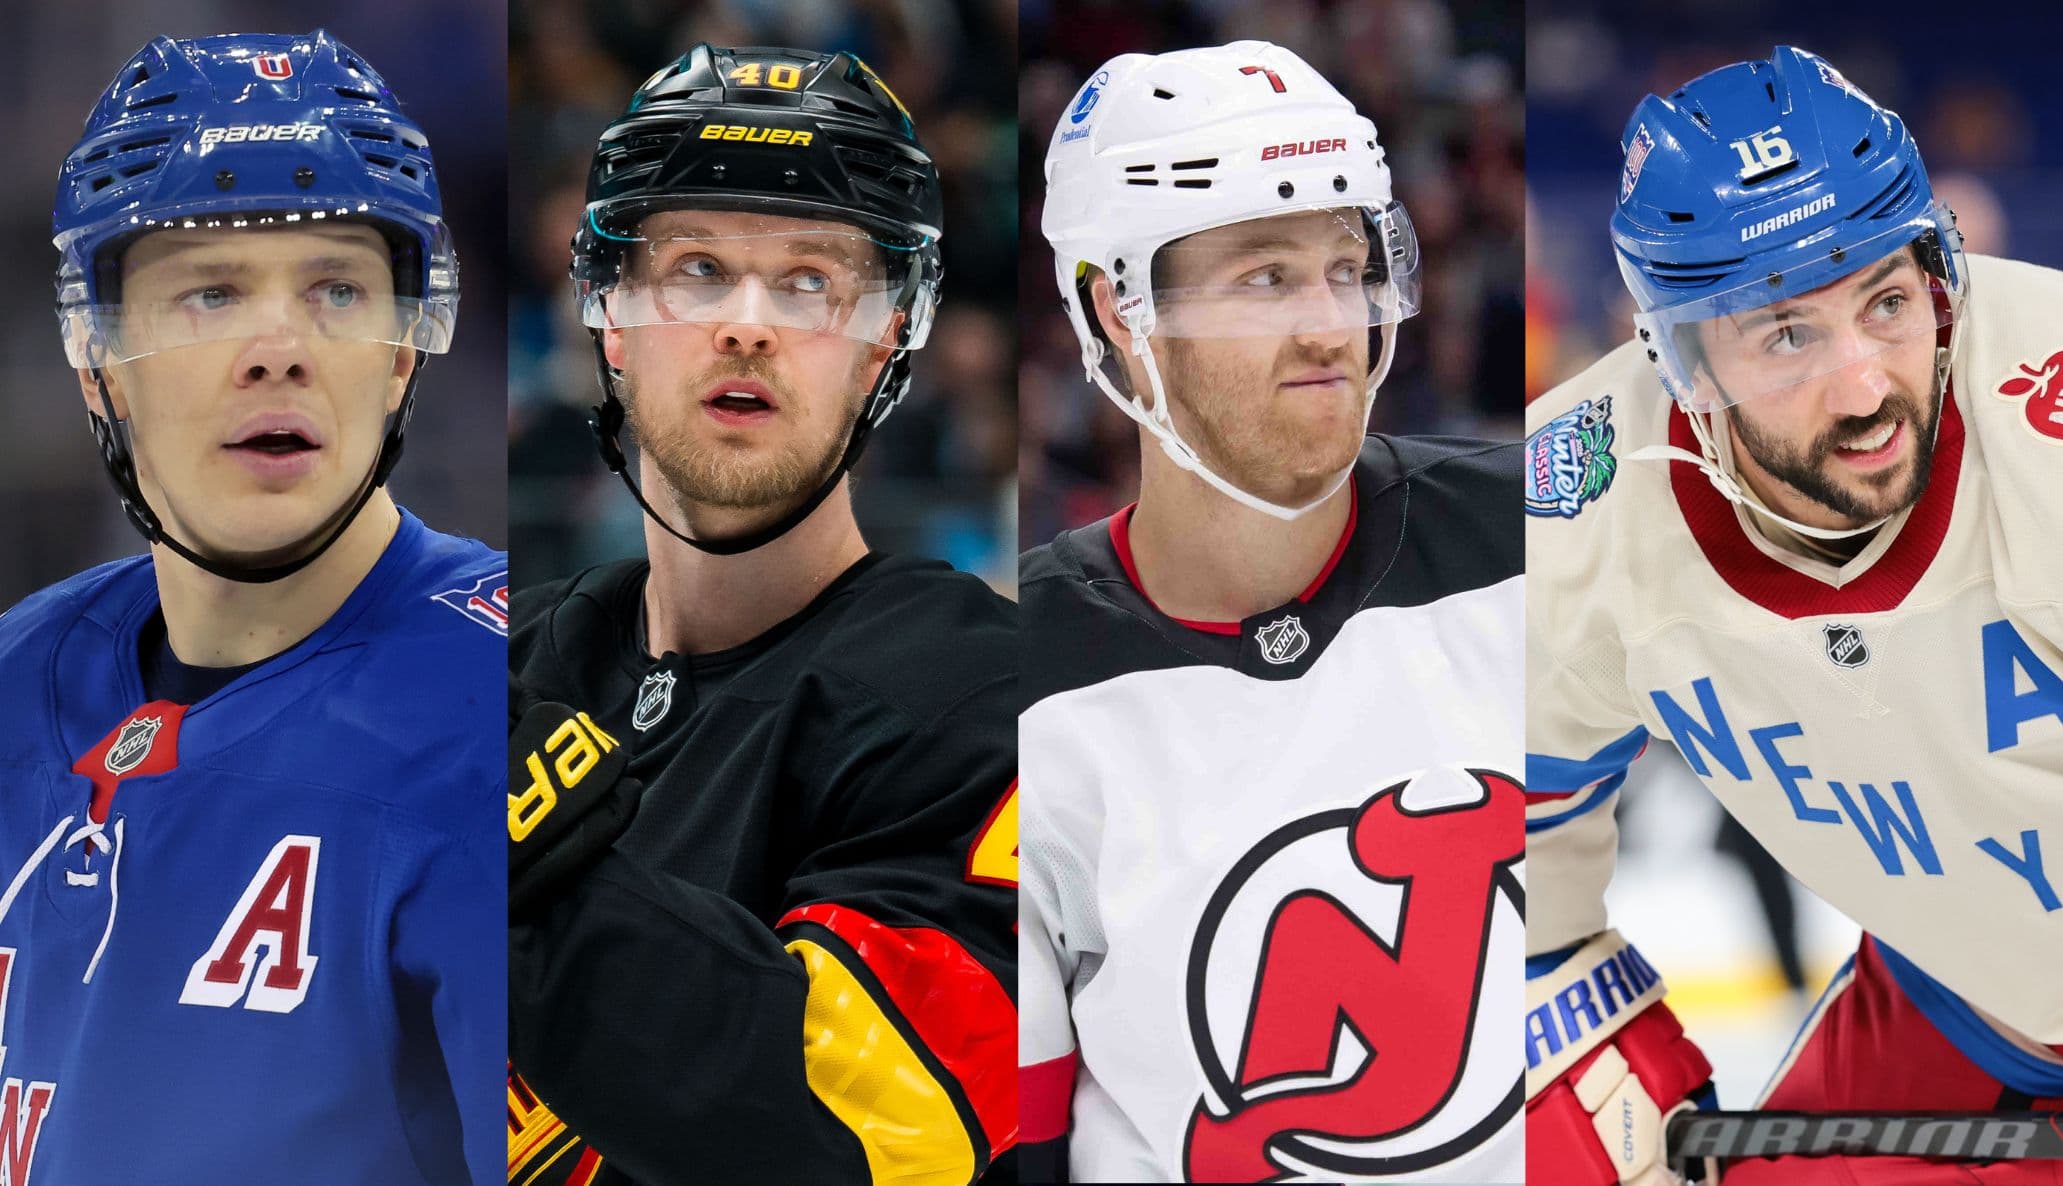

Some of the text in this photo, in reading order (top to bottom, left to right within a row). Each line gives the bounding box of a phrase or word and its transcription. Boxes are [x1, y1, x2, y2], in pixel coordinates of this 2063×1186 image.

[730, 63, 800, 90] 40
[1238, 66, 1288, 94] 7
[199, 123, 326, 145] BAUER
[699, 124, 814, 147] BAUER
[1060, 124, 1091, 144] Prudential
[1261, 138, 1348, 162] BAUER
[1729, 125, 1793, 179] 16
[1741, 193, 1836, 242] WARRIOR
[1535, 432, 1553, 498] CLASSIC
[1273, 627, 1296, 658] NHL
[1835, 634, 1859, 661] NHL
[1982, 619, 2063, 753] A
[638, 686, 665, 719] NHL
[113, 731, 149, 762] NHL
[1649, 676, 1944, 876] NEW
[178, 834, 321, 1013] A
[1622, 1098, 1635, 1163] COVERT
